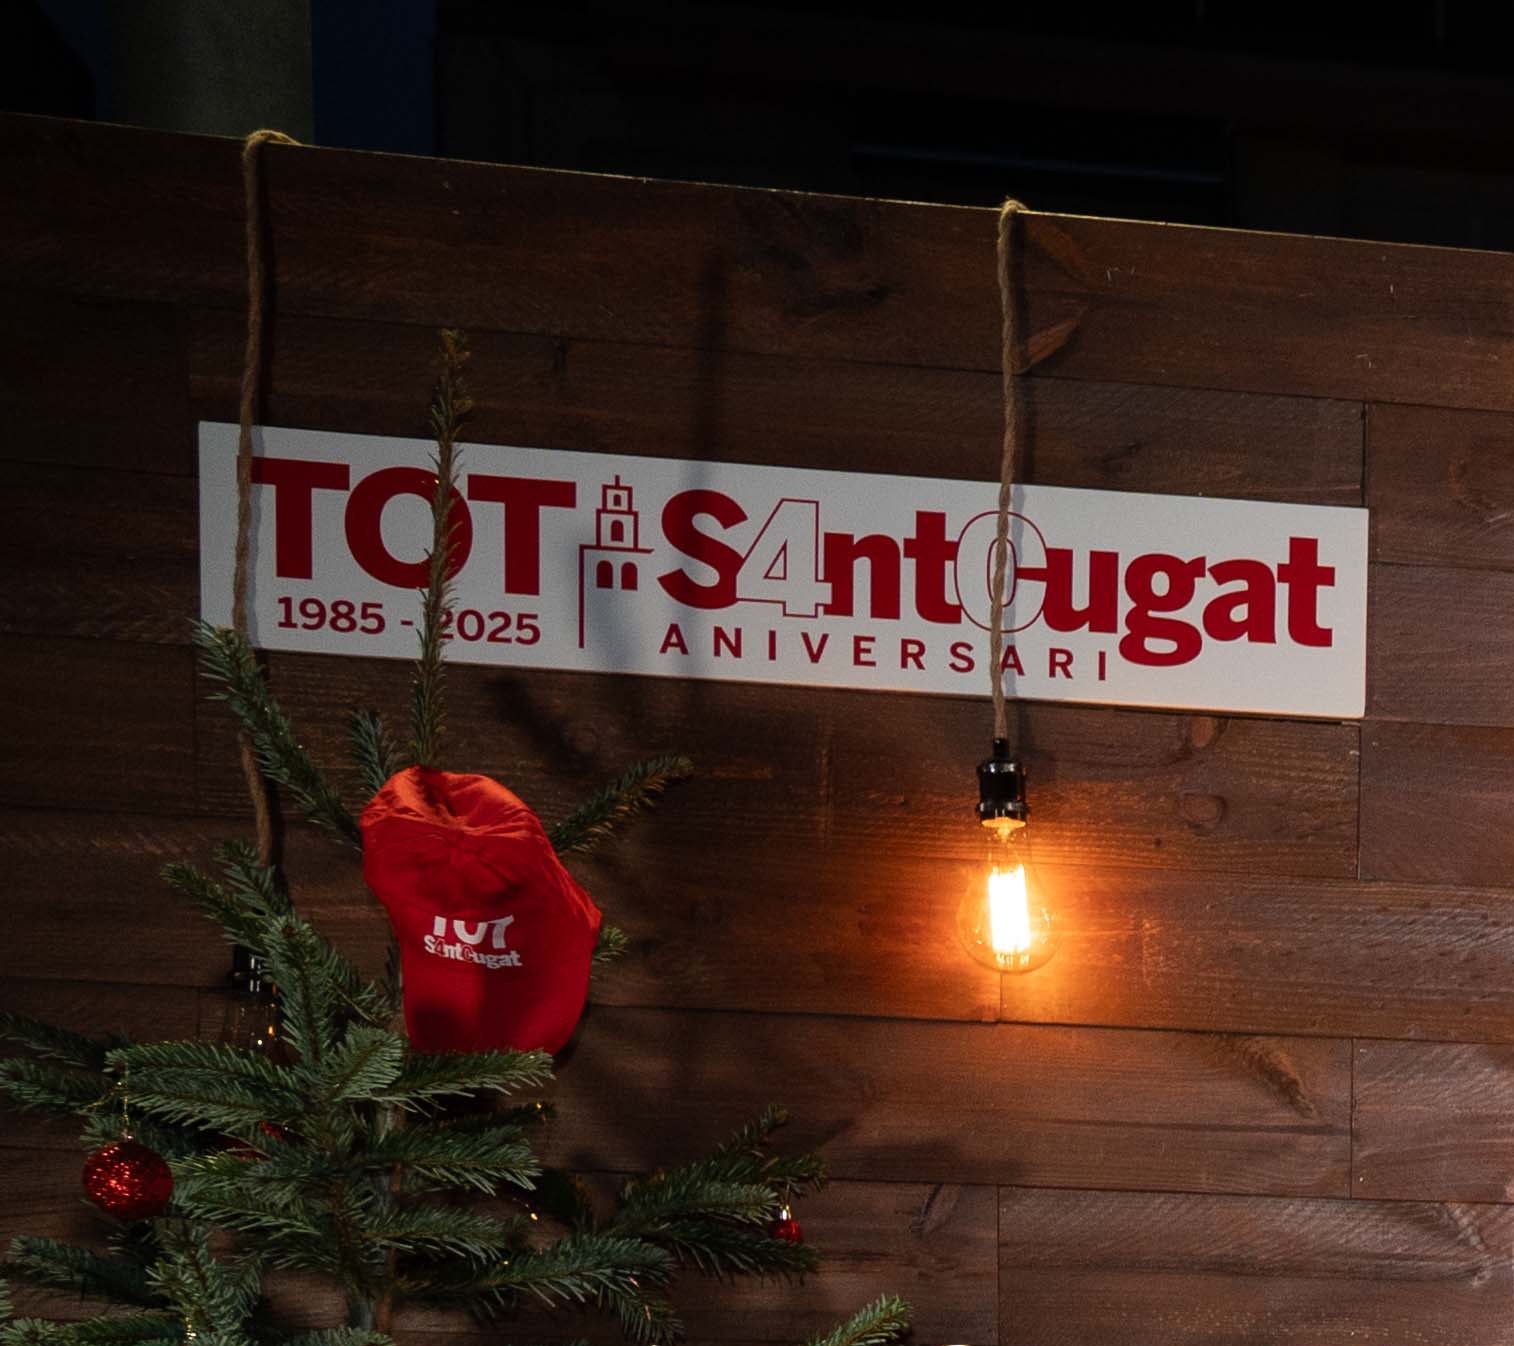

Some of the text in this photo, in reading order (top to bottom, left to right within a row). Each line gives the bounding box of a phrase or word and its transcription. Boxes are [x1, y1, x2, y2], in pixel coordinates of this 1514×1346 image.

[237, 455, 577, 597] TOT
[277, 596, 386, 635] 1985
[660, 622, 1107, 681] ANIVERSARI
